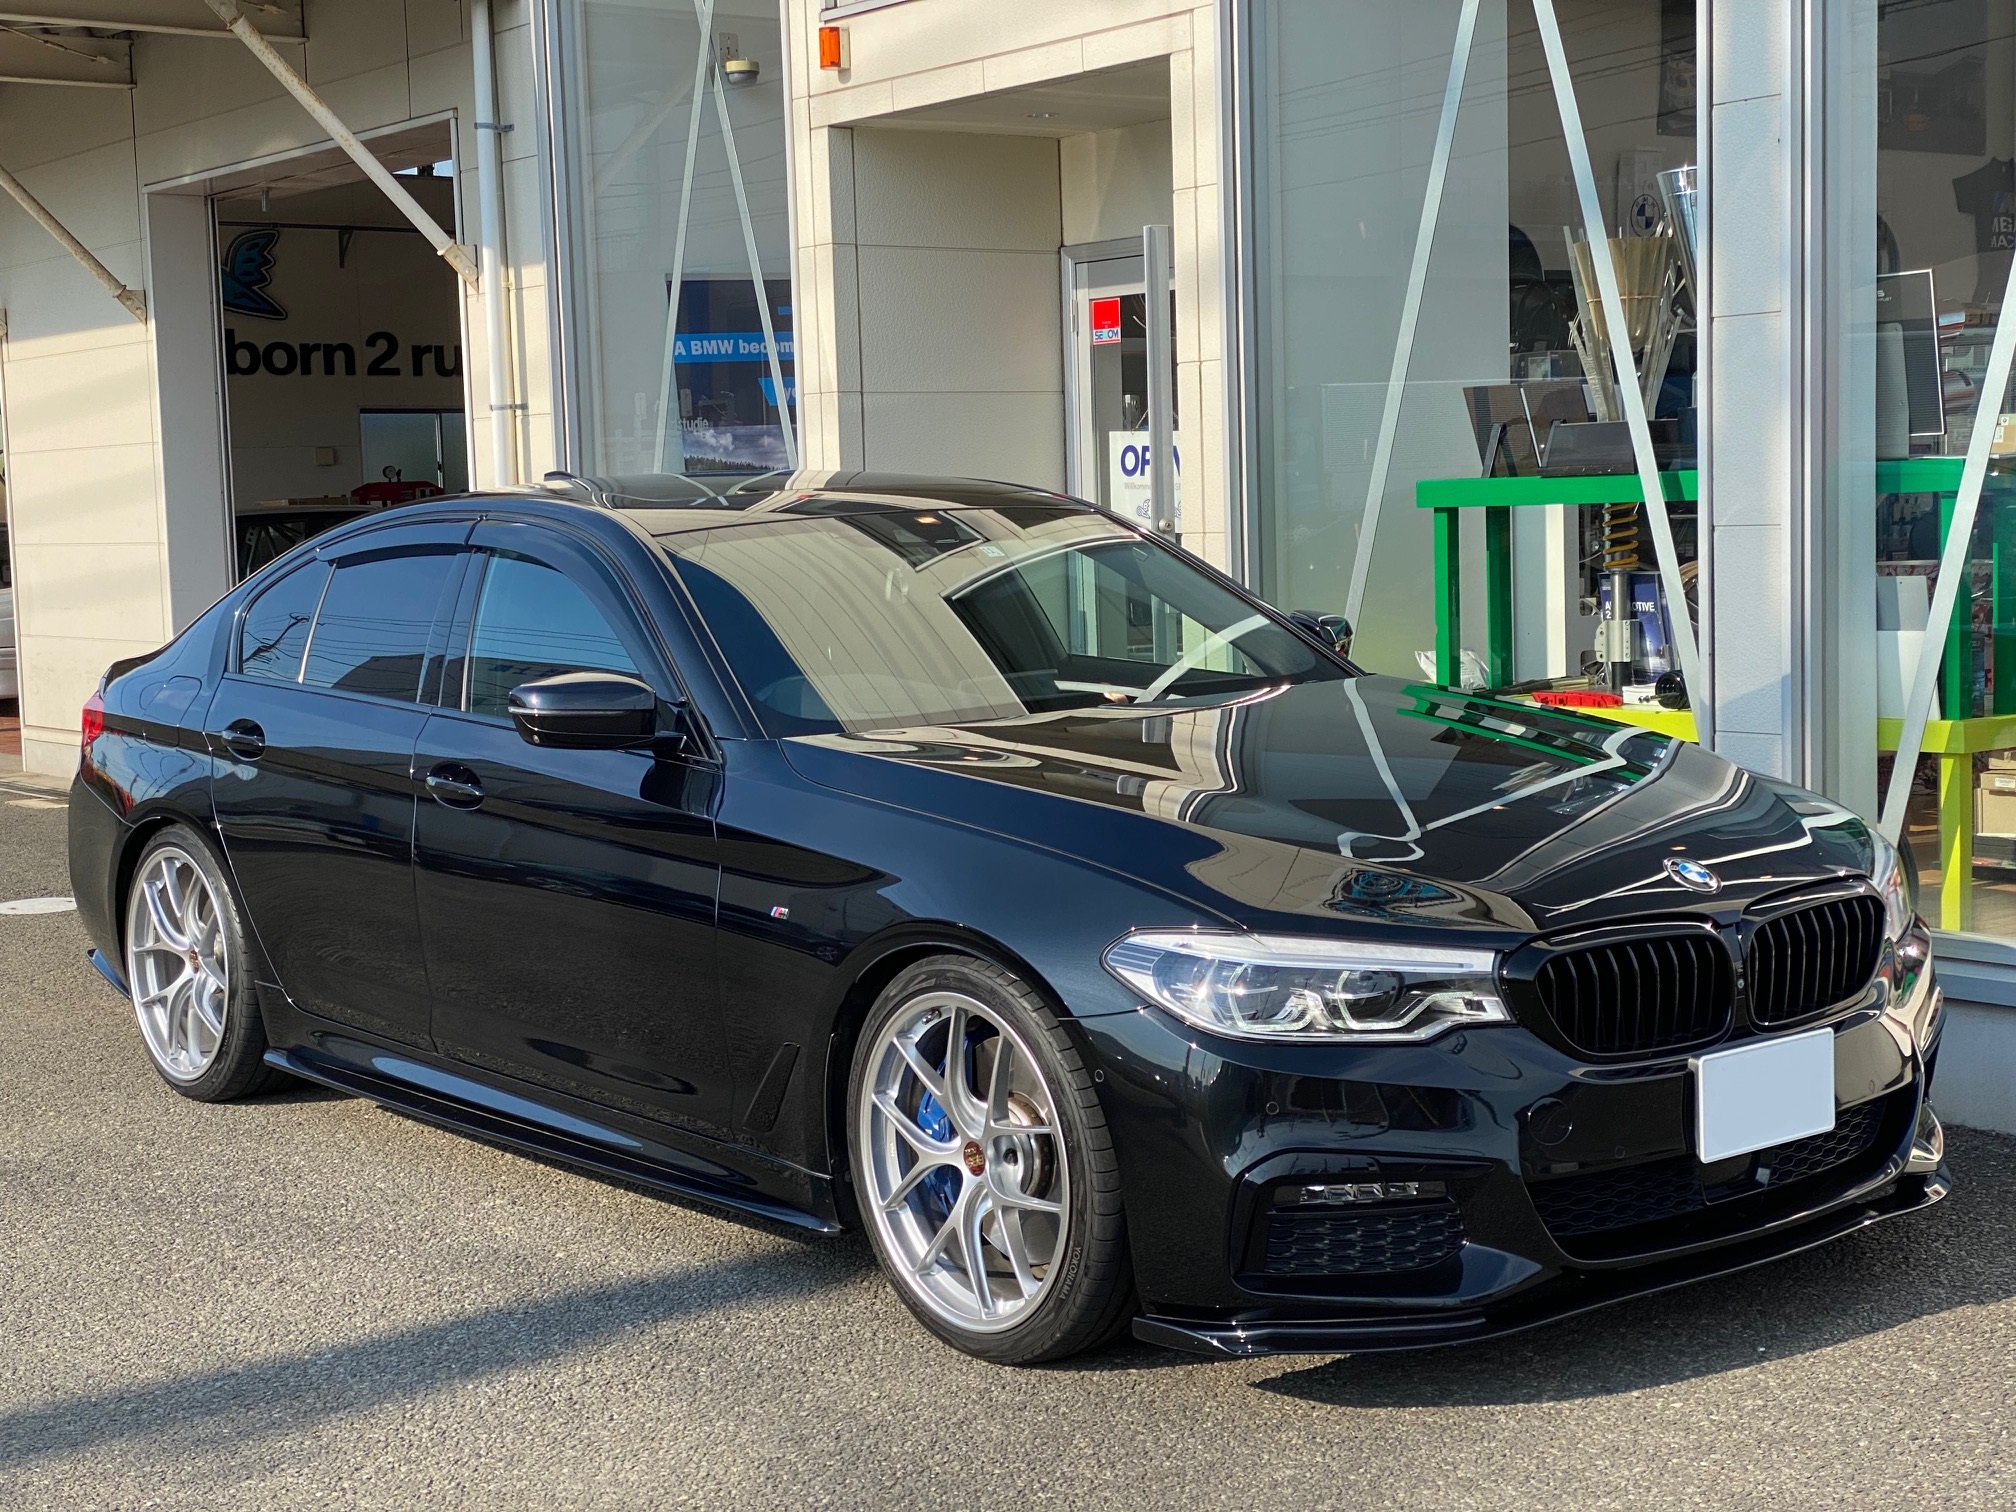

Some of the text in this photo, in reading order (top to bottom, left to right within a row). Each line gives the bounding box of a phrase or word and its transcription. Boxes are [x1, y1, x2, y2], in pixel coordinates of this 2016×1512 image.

[225, 329, 463, 377] born 2 ru
[674, 341, 687, 355] A
[690, 340, 733, 355] BMW
[677, 417, 709, 432] studie
[1059, 1246, 1082, 1300] YOKOHAMA
